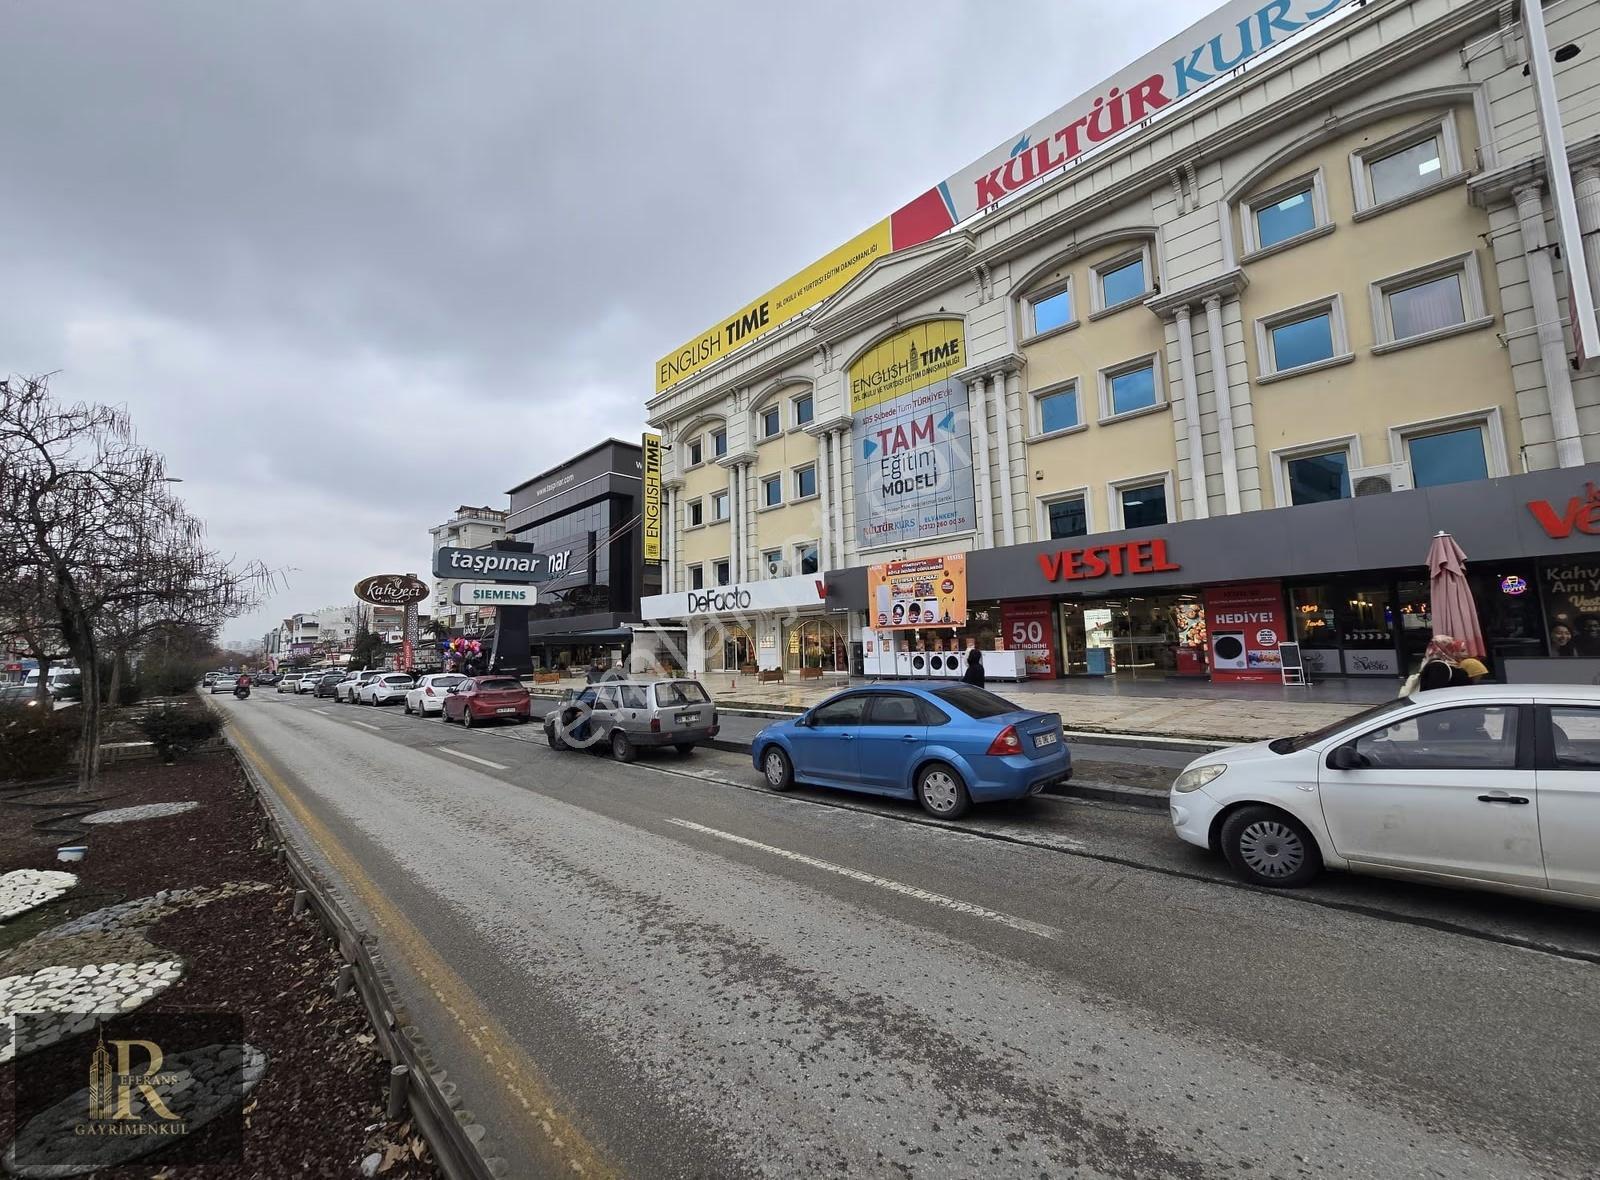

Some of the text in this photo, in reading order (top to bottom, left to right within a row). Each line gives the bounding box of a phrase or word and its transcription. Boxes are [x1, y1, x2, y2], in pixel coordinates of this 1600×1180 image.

[660, 301, 769, 384] ENGLISH TIME
[853, 338, 959, 394] ENGLISH TIME
[877, 414, 935, 456] TAM
[647, 440, 659, 474] TIME
[881, 449, 936, 479] Eğitim
[882, 467, 937, 498] MODELİ
[646, 477, 659, 538] ENGLISH
[924, 511, 957, 523] ELVANKENT
[450, 551, 540, 574] taşpınar
[1037, 538, 1181, 581] VESTEL
[473, 589, 526, 600] SIEMENS
[688, 586, 751, 614] DeFacto
[1012, 621, 1042, 643] 50
[1216, 611, 1273, 624] HEDİYE!
